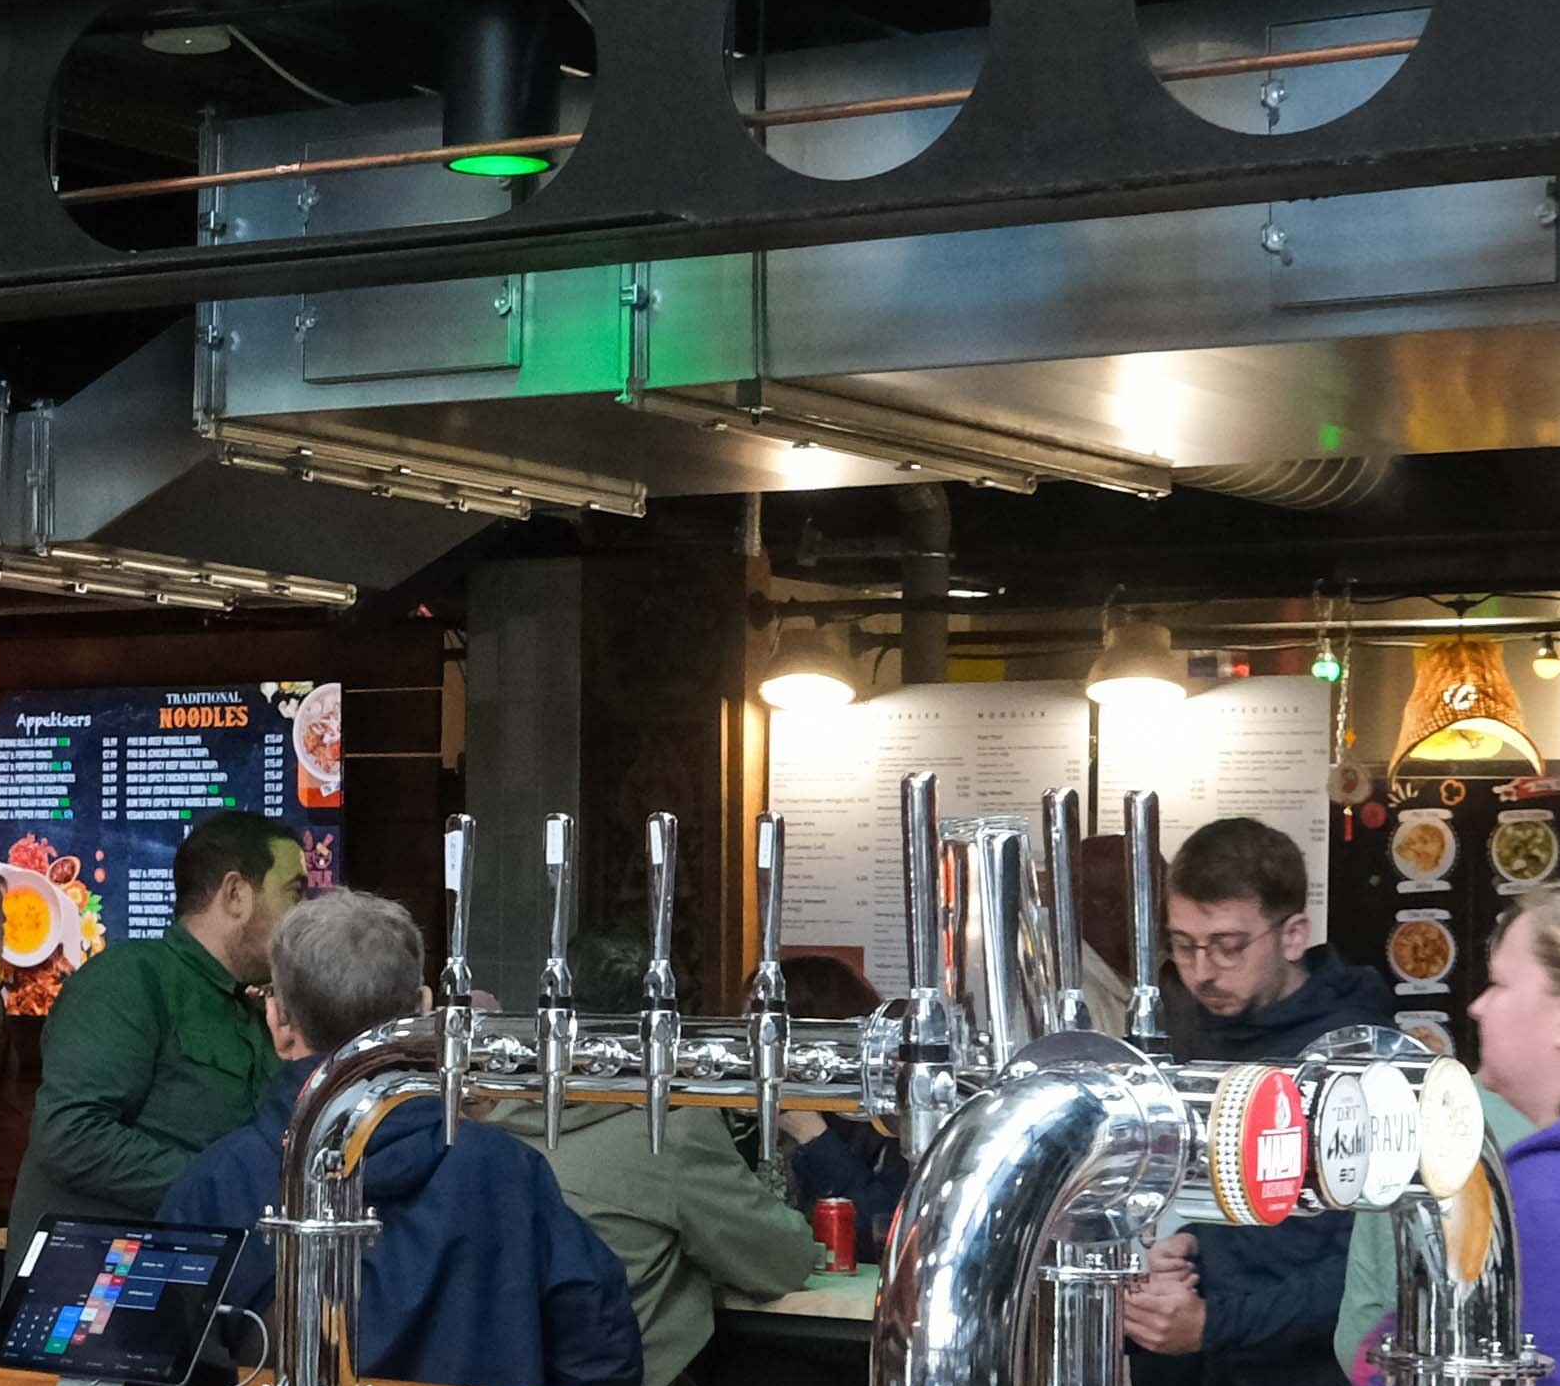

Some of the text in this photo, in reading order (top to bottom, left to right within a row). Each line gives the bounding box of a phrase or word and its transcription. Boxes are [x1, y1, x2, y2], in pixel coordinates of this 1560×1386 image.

[165, 691, 242, 704] TRADITIONAL
[16, 711, 91, 736] Appetisers
[159, 706, 248, 729] NOODLES
[1327, 1124, 1366, 1160] Asahi
[1371, 1113, 1418, 1153] RAVH
